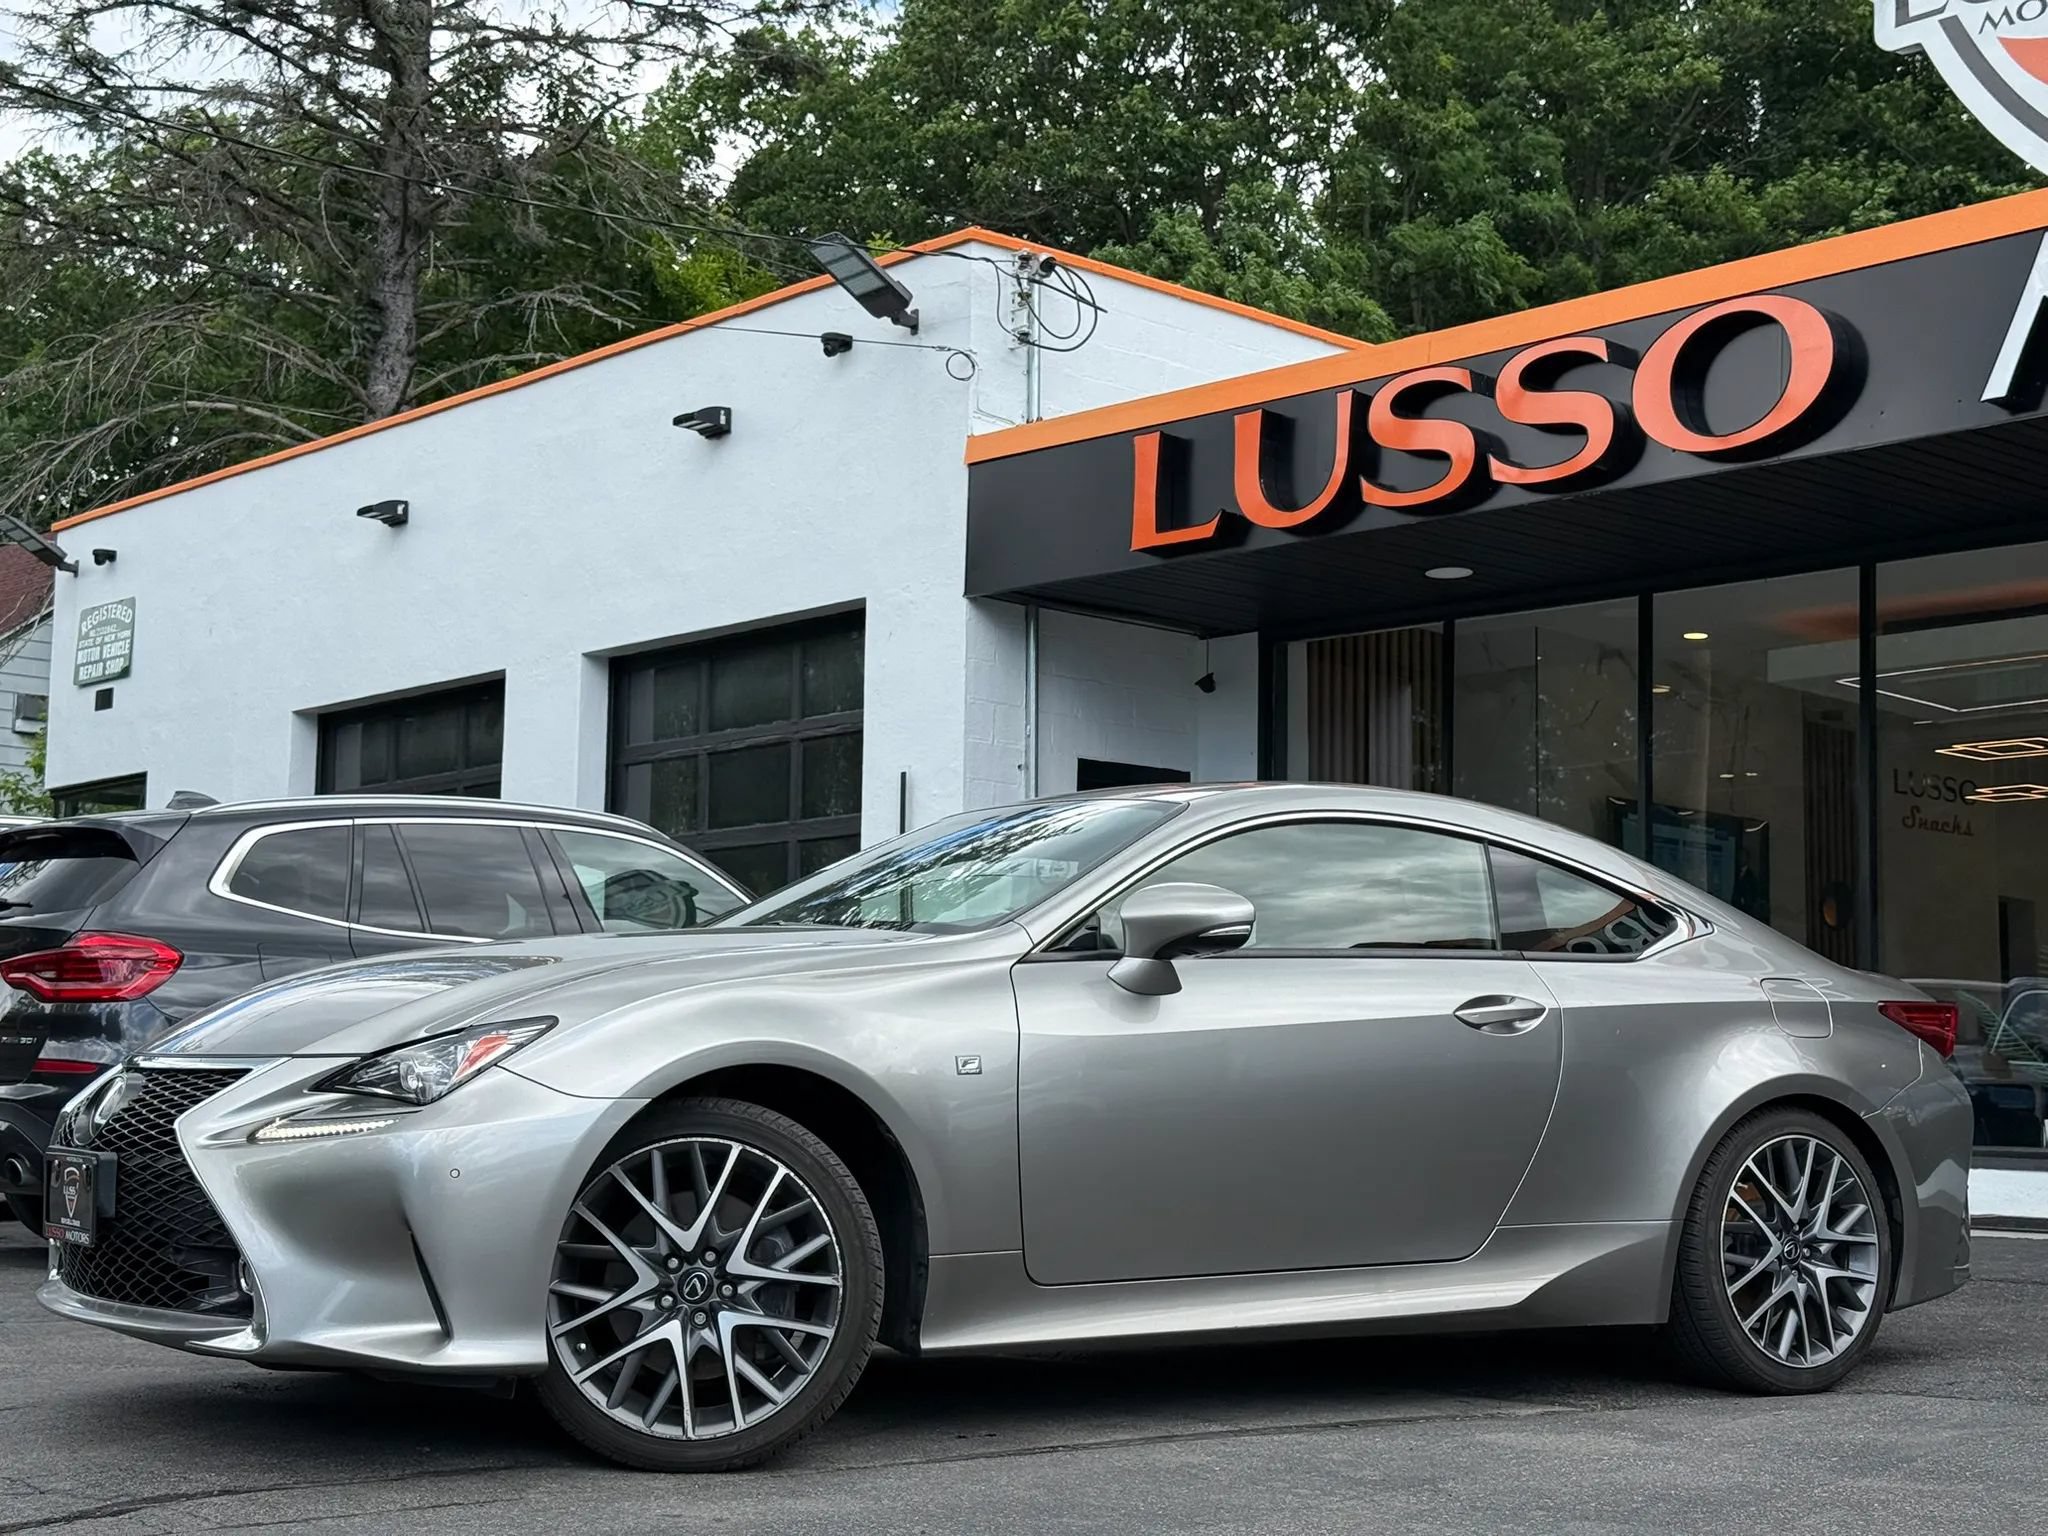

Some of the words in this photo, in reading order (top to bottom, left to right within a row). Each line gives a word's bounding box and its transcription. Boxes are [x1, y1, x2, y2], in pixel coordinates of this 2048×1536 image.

[1130, 294, 1835, 552] LUSSO
[81, 603, 133, 636] REGISTERED
[77, 646, 100, 664] MOTOR
[102, 639, 130, 660] VEHICLE
[79, 662, 103, 680] REPAIR
[105, 657, 124, 675] SHOP
[65, 1231, 90, 1244] MOTORS
